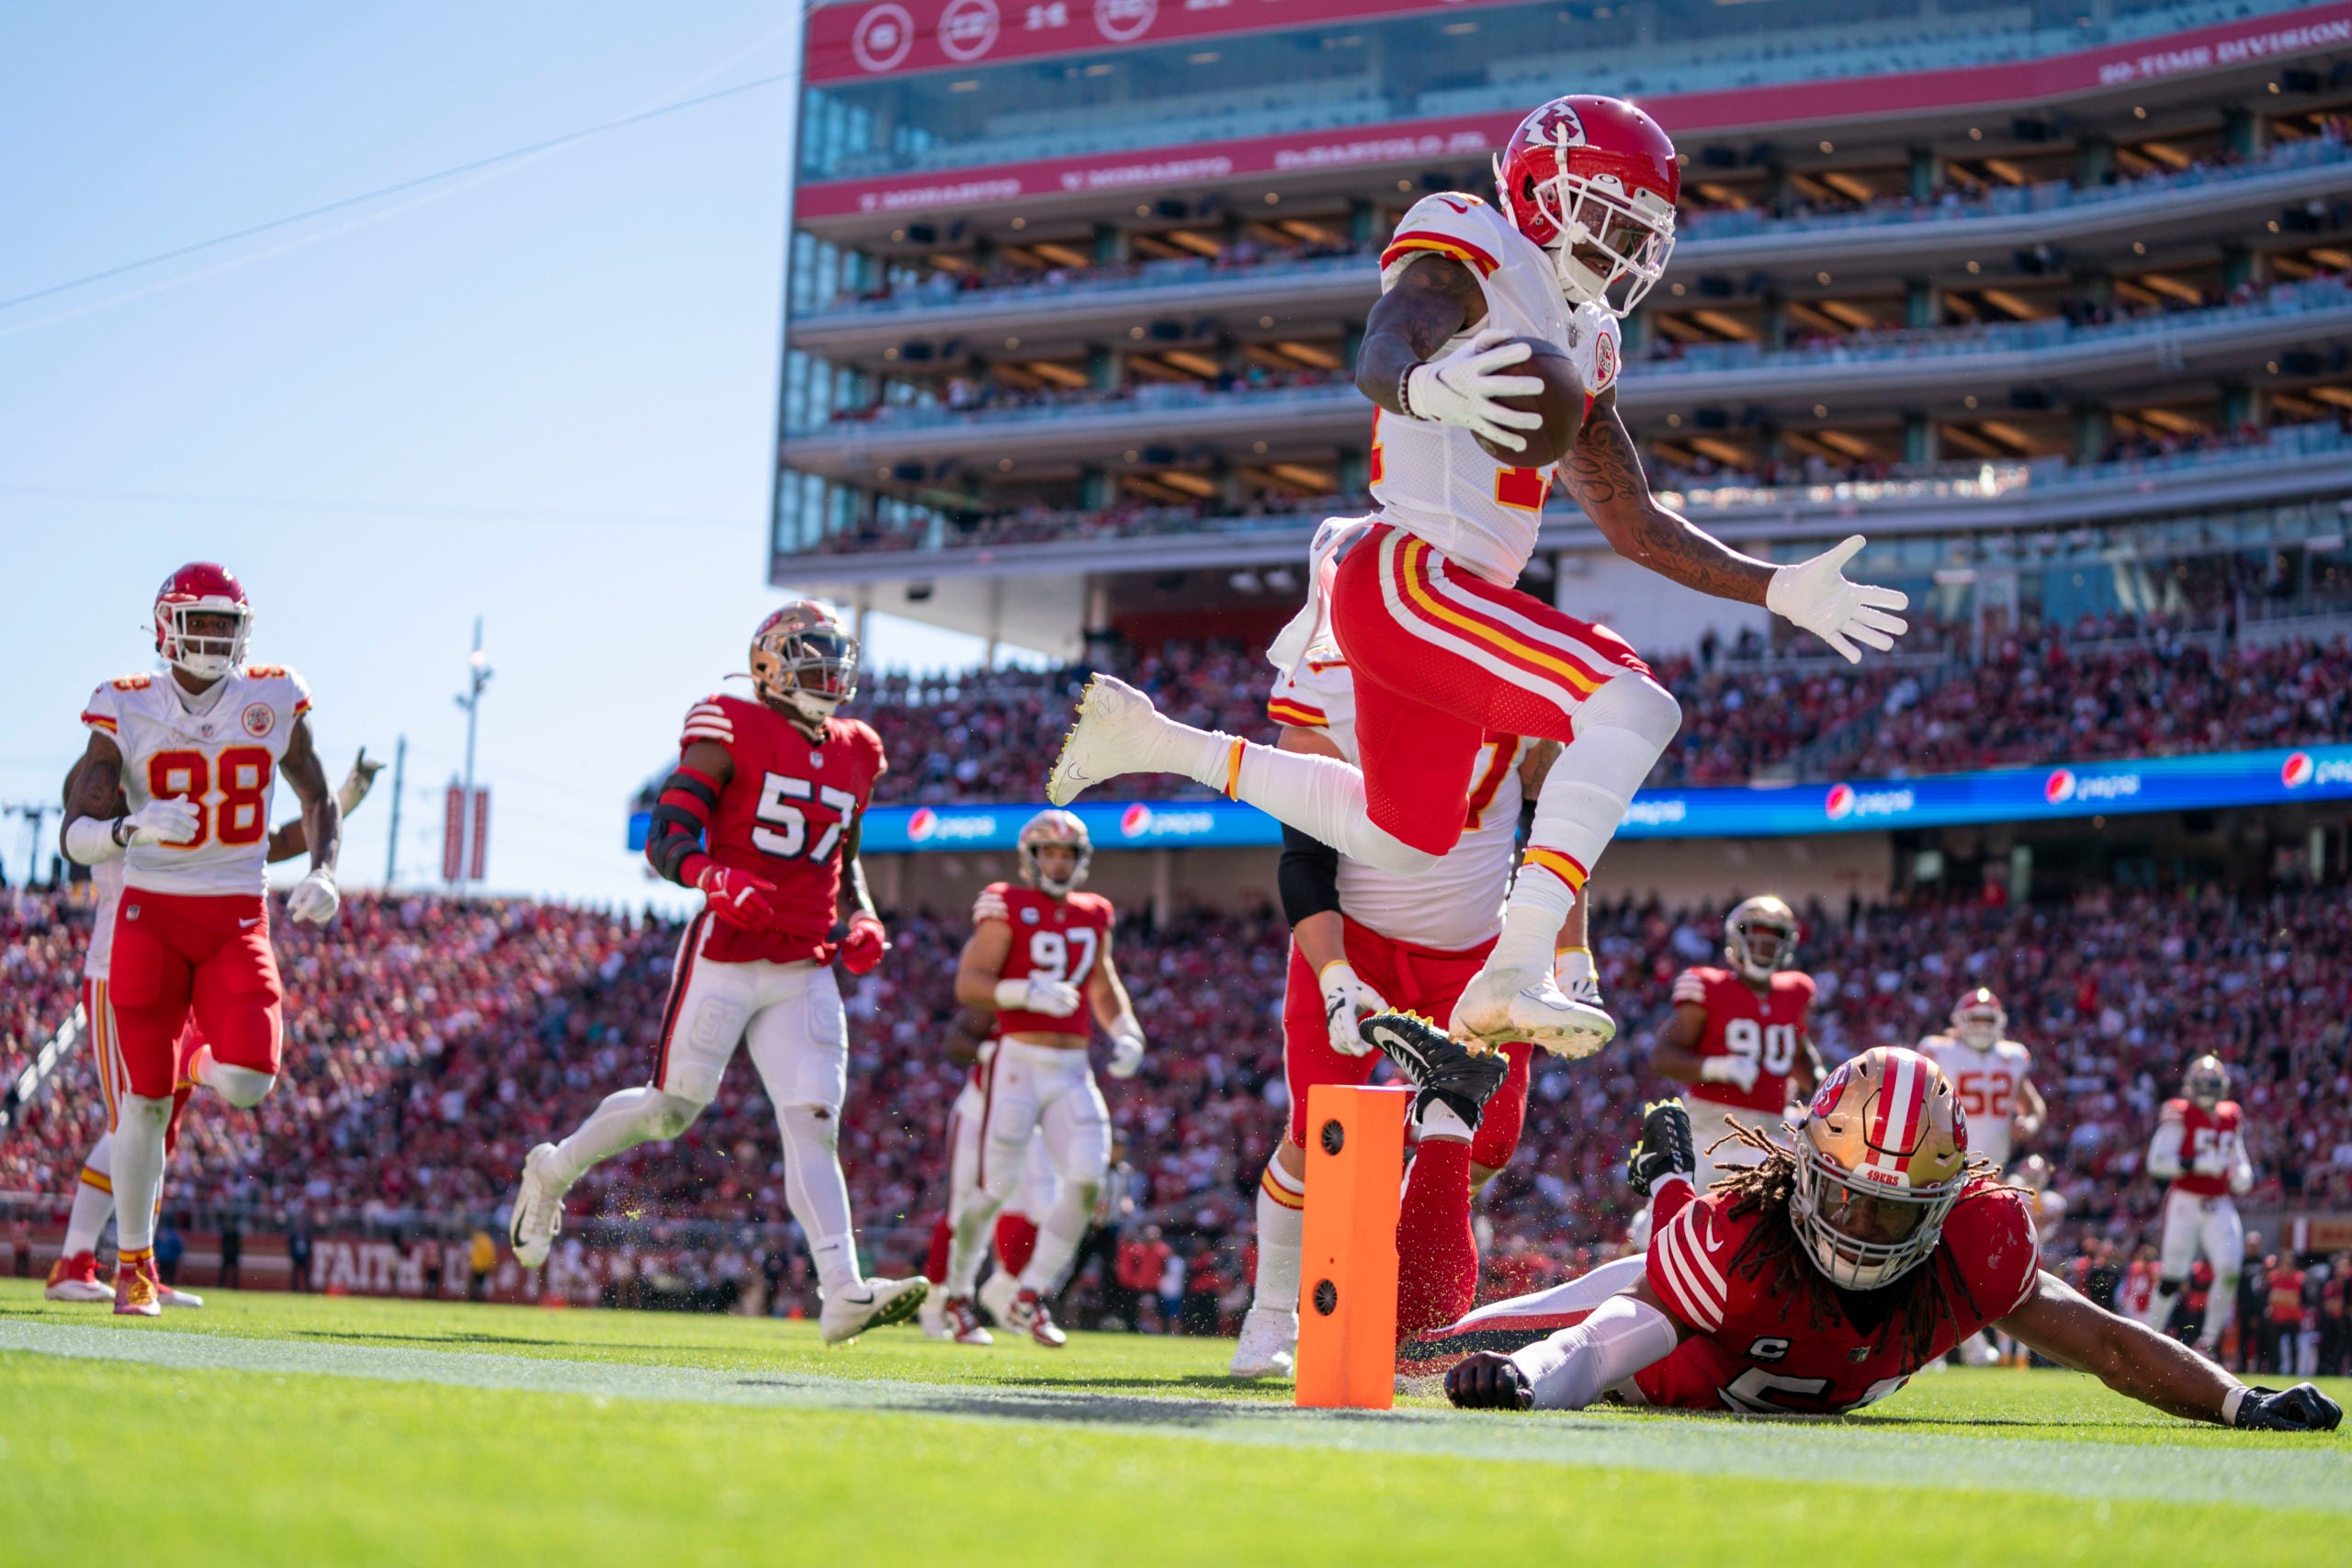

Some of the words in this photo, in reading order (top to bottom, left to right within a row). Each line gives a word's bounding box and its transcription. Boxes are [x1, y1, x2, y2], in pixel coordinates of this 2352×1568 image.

[2217, 18, 2351, 63] DIVISION
[147, 746, 273, 851] 88
[1853, 789, 1915, 817] pepsi
[2076, 774, 2141, 801] pepsi
[751, 770, 857, 866] 57
[933, 815, 997, 840] pepsi
[1148, 811, 1215, 836] pepsi
[1029, 926, 1098, 986] 97
[1724, 1017, 1796, 1077] 90
[1957, 1070, 2013, 1118] 52
[1866, 1168, 1900, 1187] 49ERS
[1749, 1337, 1789, 1359] C
